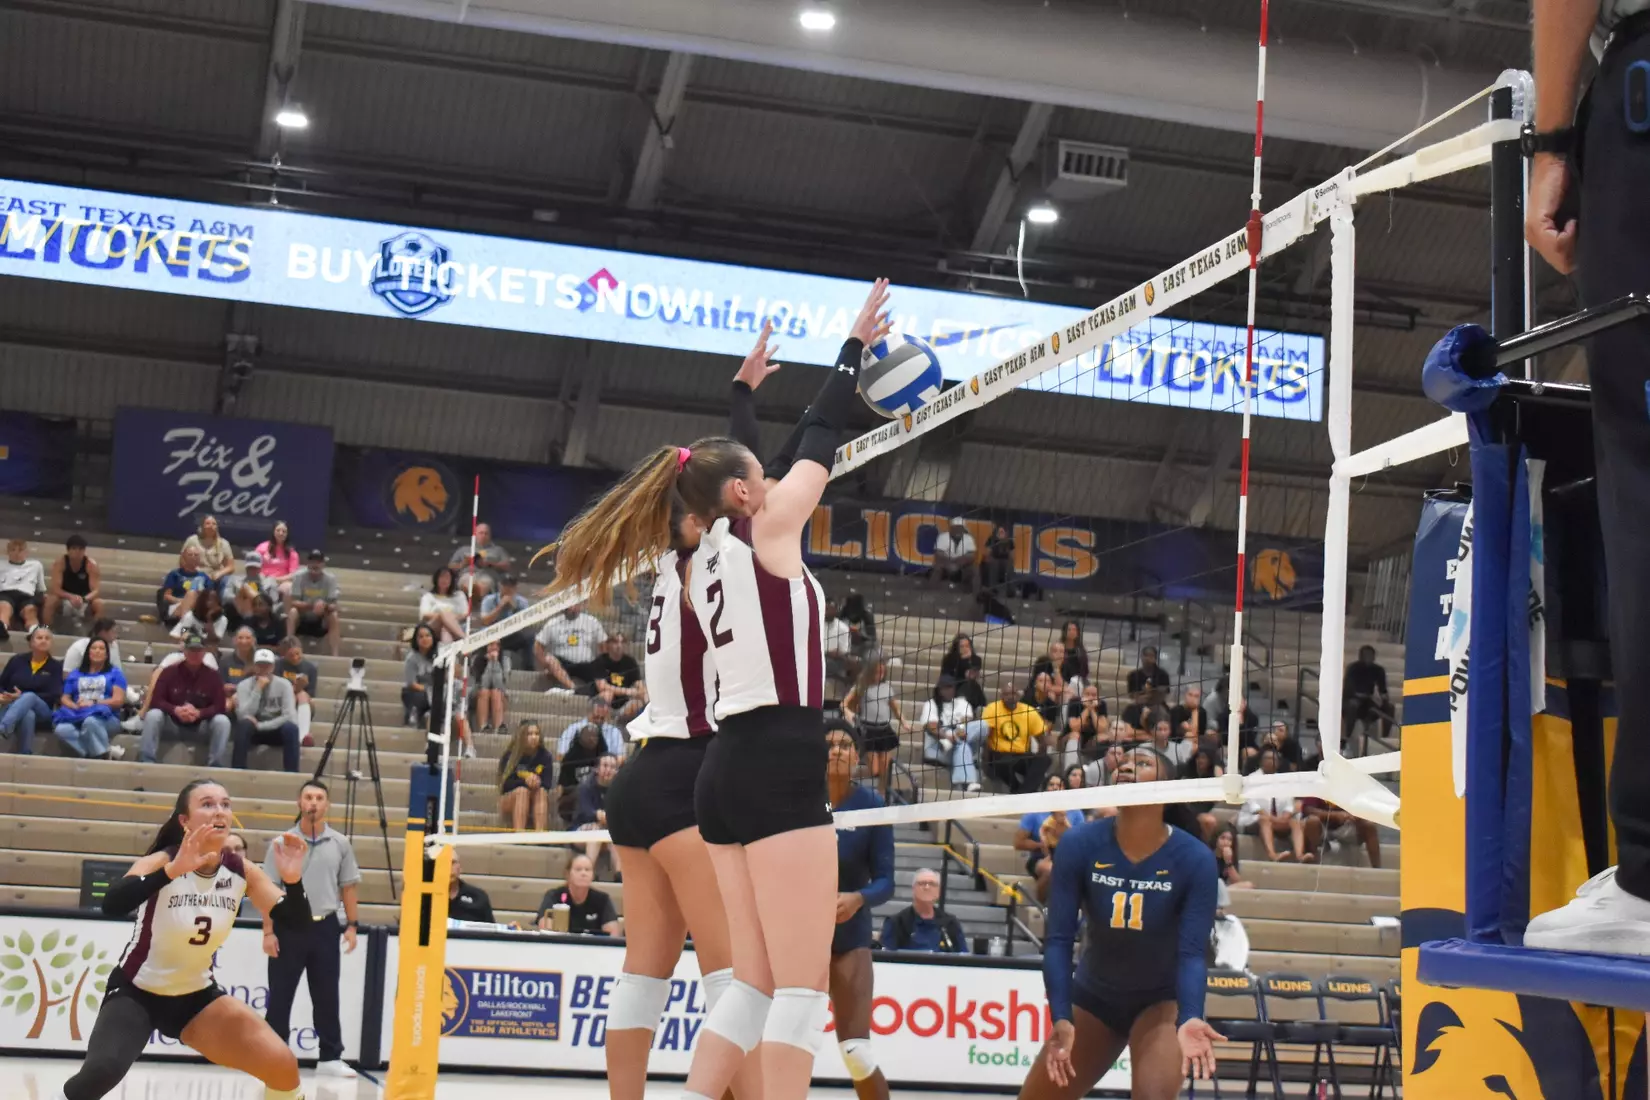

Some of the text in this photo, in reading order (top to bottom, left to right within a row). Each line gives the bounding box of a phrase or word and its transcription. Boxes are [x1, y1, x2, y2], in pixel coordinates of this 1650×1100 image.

[0, 196, 254, 240] AST TEXAS A&M
[287, 243, 383, 287] BUY
[392, 255, 583, 310] TICKETS
[1162, 231, 1248, 294] EAST TEXAS A&M
[1066, 293, 1137, 344] EAST TEXAS A&M
[1167, 335, 1246, 355] TEXAS
[1257, 346, 1309, 363] A&M
[984, 366, 1003, 386] EAST
[1004, 352, 1027, 375] TEXAS
[162, 427, 277, 488] Fix &
[178, 471, 282, 517] Feed
[706, 579, 734, 648] 2
[1092, 872, 1172, 892] EAST TEXAS
[1110, 891, 1144, 931] 11
[188, 916, 212, 945] 3
[471, 972, 555, 999] Hilton
[1206, 976, 1249, 988] LIONS
[1269, 979, 1312, 992] LIONS
[1328, 980, 1372, 993] LIONS
[469, 1025, 557, 1036] LION ATHLETICS
[571, 1013, 608, 1047] TO
[968, 1045, 1031, 1066] food &
